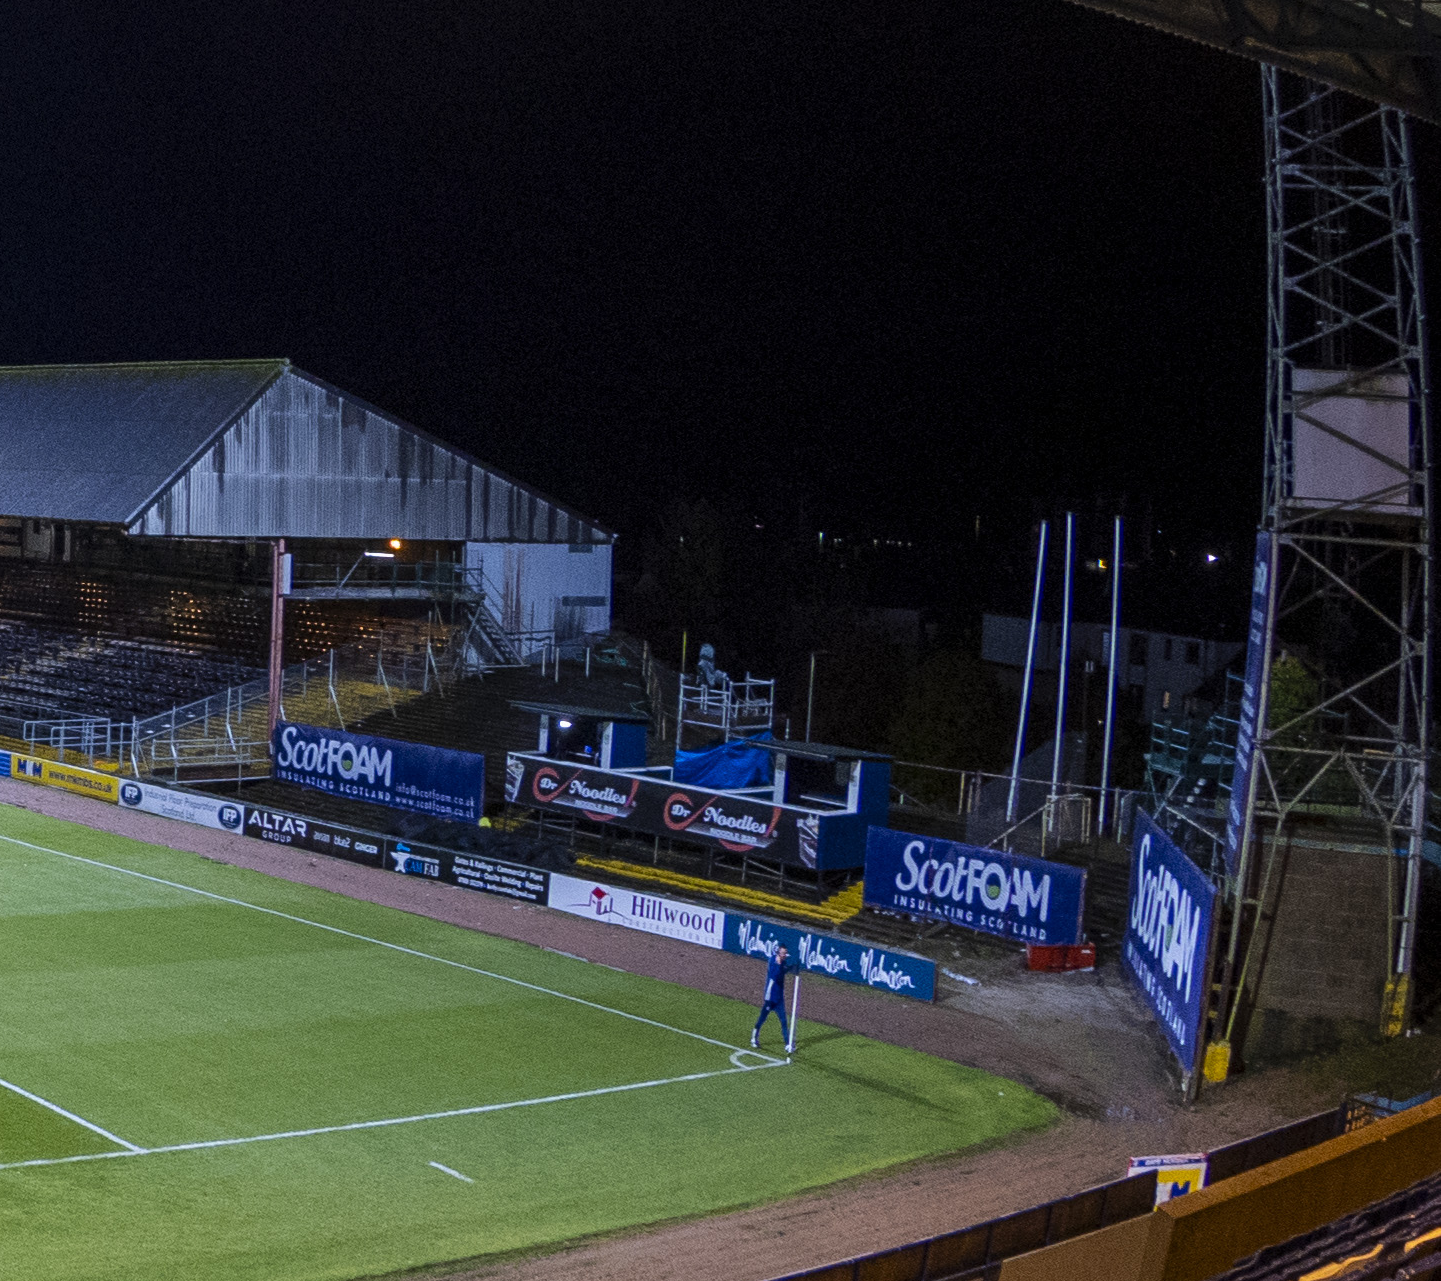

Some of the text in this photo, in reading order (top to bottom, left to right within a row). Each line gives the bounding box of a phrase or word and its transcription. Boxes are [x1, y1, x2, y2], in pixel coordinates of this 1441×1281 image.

[277, 726, 393, 788] ScotFOAM
[277, 768, 392, 803] INSULATING SCOTLAND
[395, 782, 475, 808] info@scotfoam.co.uk
[540, 777, 558, 790] Dr
[568, 778, 628, 807] Noodles
[395, 794, 475, 820] www.scotfoam.co.uk
[671, 803, 690, 818] Dr
[703, 805, 768, 835] Noodles
[248, 810, 308, 838] ALTAR
[262, 830, 292, 844] GROUP
[529, 872, 544, 882] Plant
[896, 840, 1052, 923] ScotFOAM
[631, 894, 716, 934] Hillwood
[893, 894, 1047, 942] INSULATING SCOTLAND
[1131, 833, 1202, 1004] ScotFOAM
